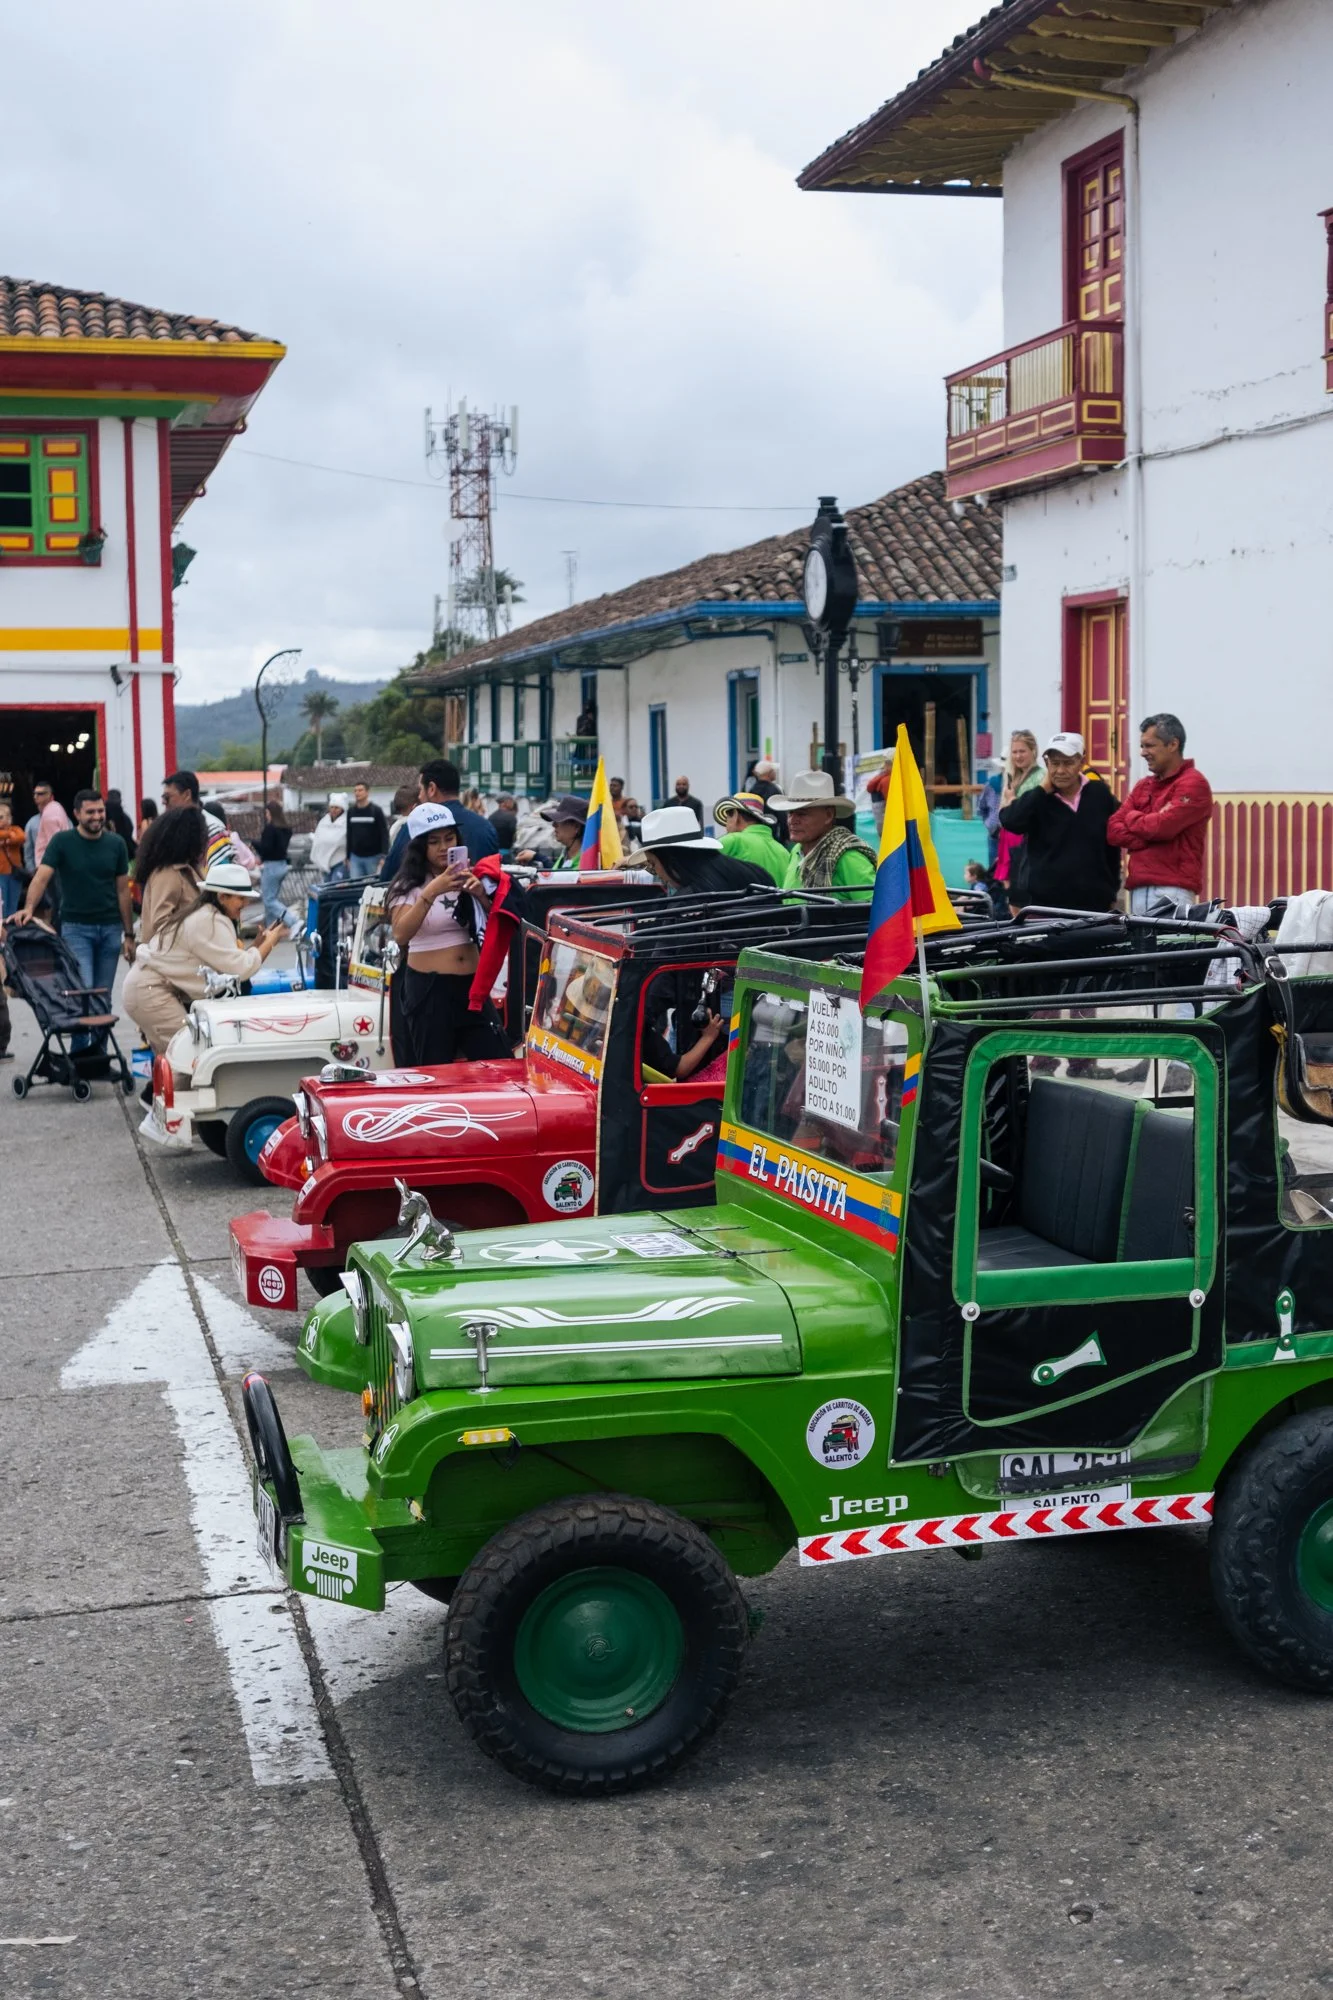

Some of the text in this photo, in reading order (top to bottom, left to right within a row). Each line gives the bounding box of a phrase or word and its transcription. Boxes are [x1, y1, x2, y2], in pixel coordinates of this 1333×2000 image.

[811, 1000, 839, 1020] VUELTA
[810, 1019, 839, 1039] A $3.000
[808, 1037, 844, 1060] POR NIÑO
[808, 1055, 847, 1080] $5.000 POR
[808, 1075, 838, 1095] ADULTO
[808, 1092, 856, 1121] FOTO A $1.000
[748, 1142, 848, 1221] EL PAISITA
[262, 1278, 282, 1289] Jeep
[825, 1404, 832, 1412] DE
[832, 1401, 854, 1410] CARRITOS
[859, 1408, 872, 1426] MADERA
[824, 1453, 852, 1463] SALENTO
[820, 1494, 909, 1523] Jeep
[311, 1546, 349, 1571] Jeep
